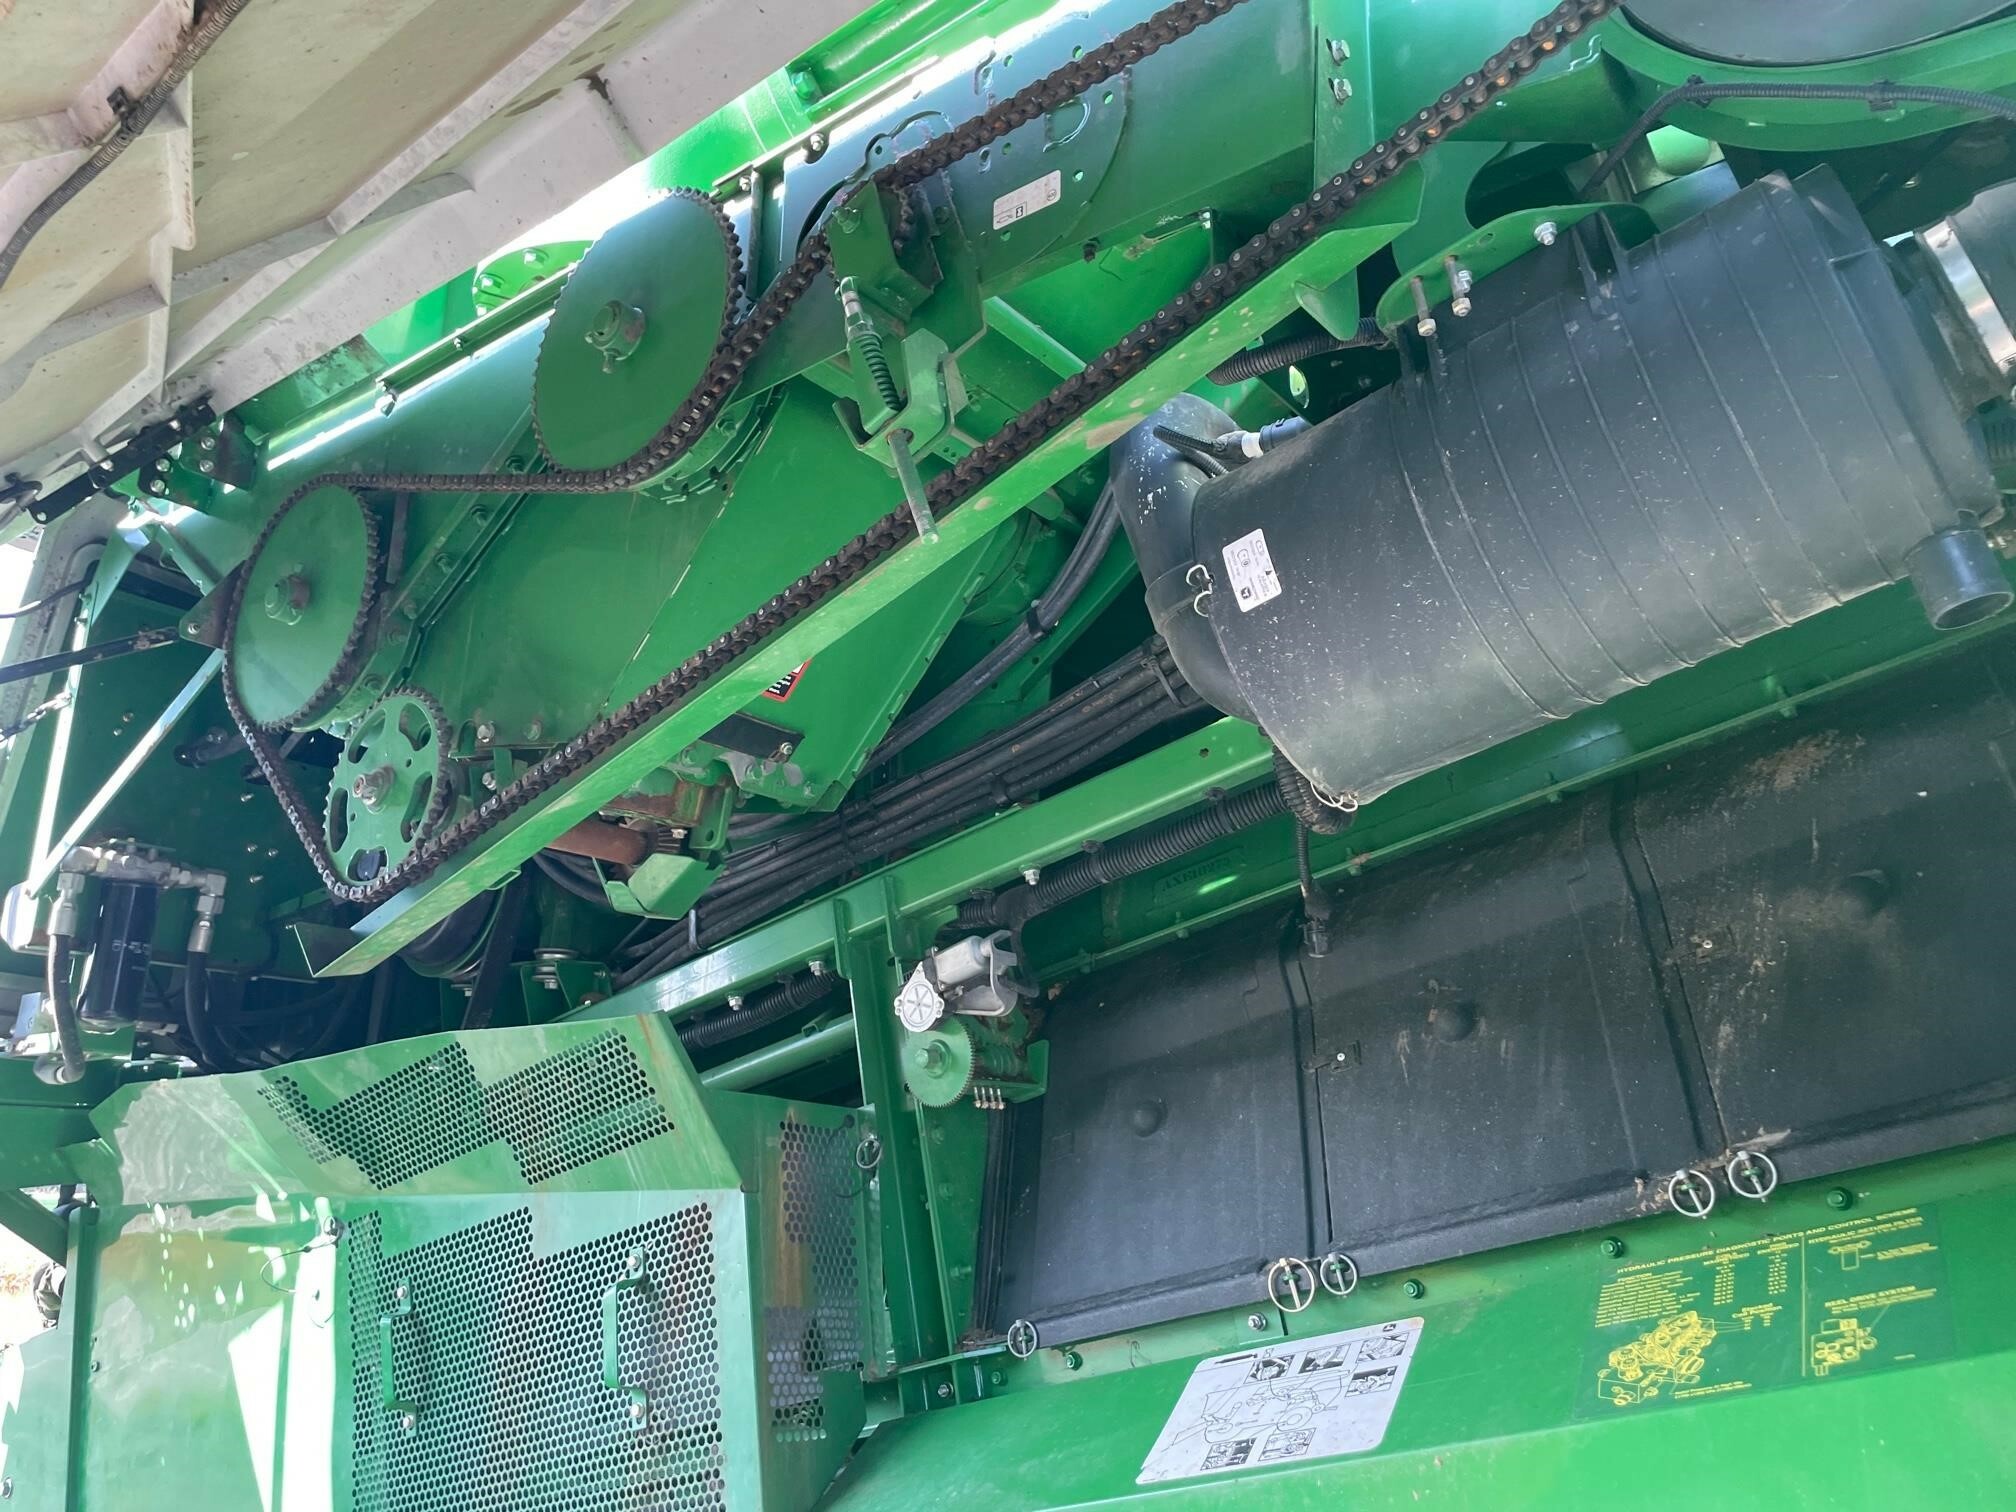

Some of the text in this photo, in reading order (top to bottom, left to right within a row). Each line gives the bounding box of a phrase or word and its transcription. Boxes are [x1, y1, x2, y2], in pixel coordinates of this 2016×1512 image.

[1617, 1259, 1665, 1274] HYDRAULIC
[1667, 1250, 1714, 1264] PRESSURE
[1716, 1238, 1771, 1254] DIAGNOSTIC
[1773, 1231, 1804, 1242] PORTS
[1806, 1227, 1826, 1235] AND
[1828, 1217, 1874, 1230] CONTROL
